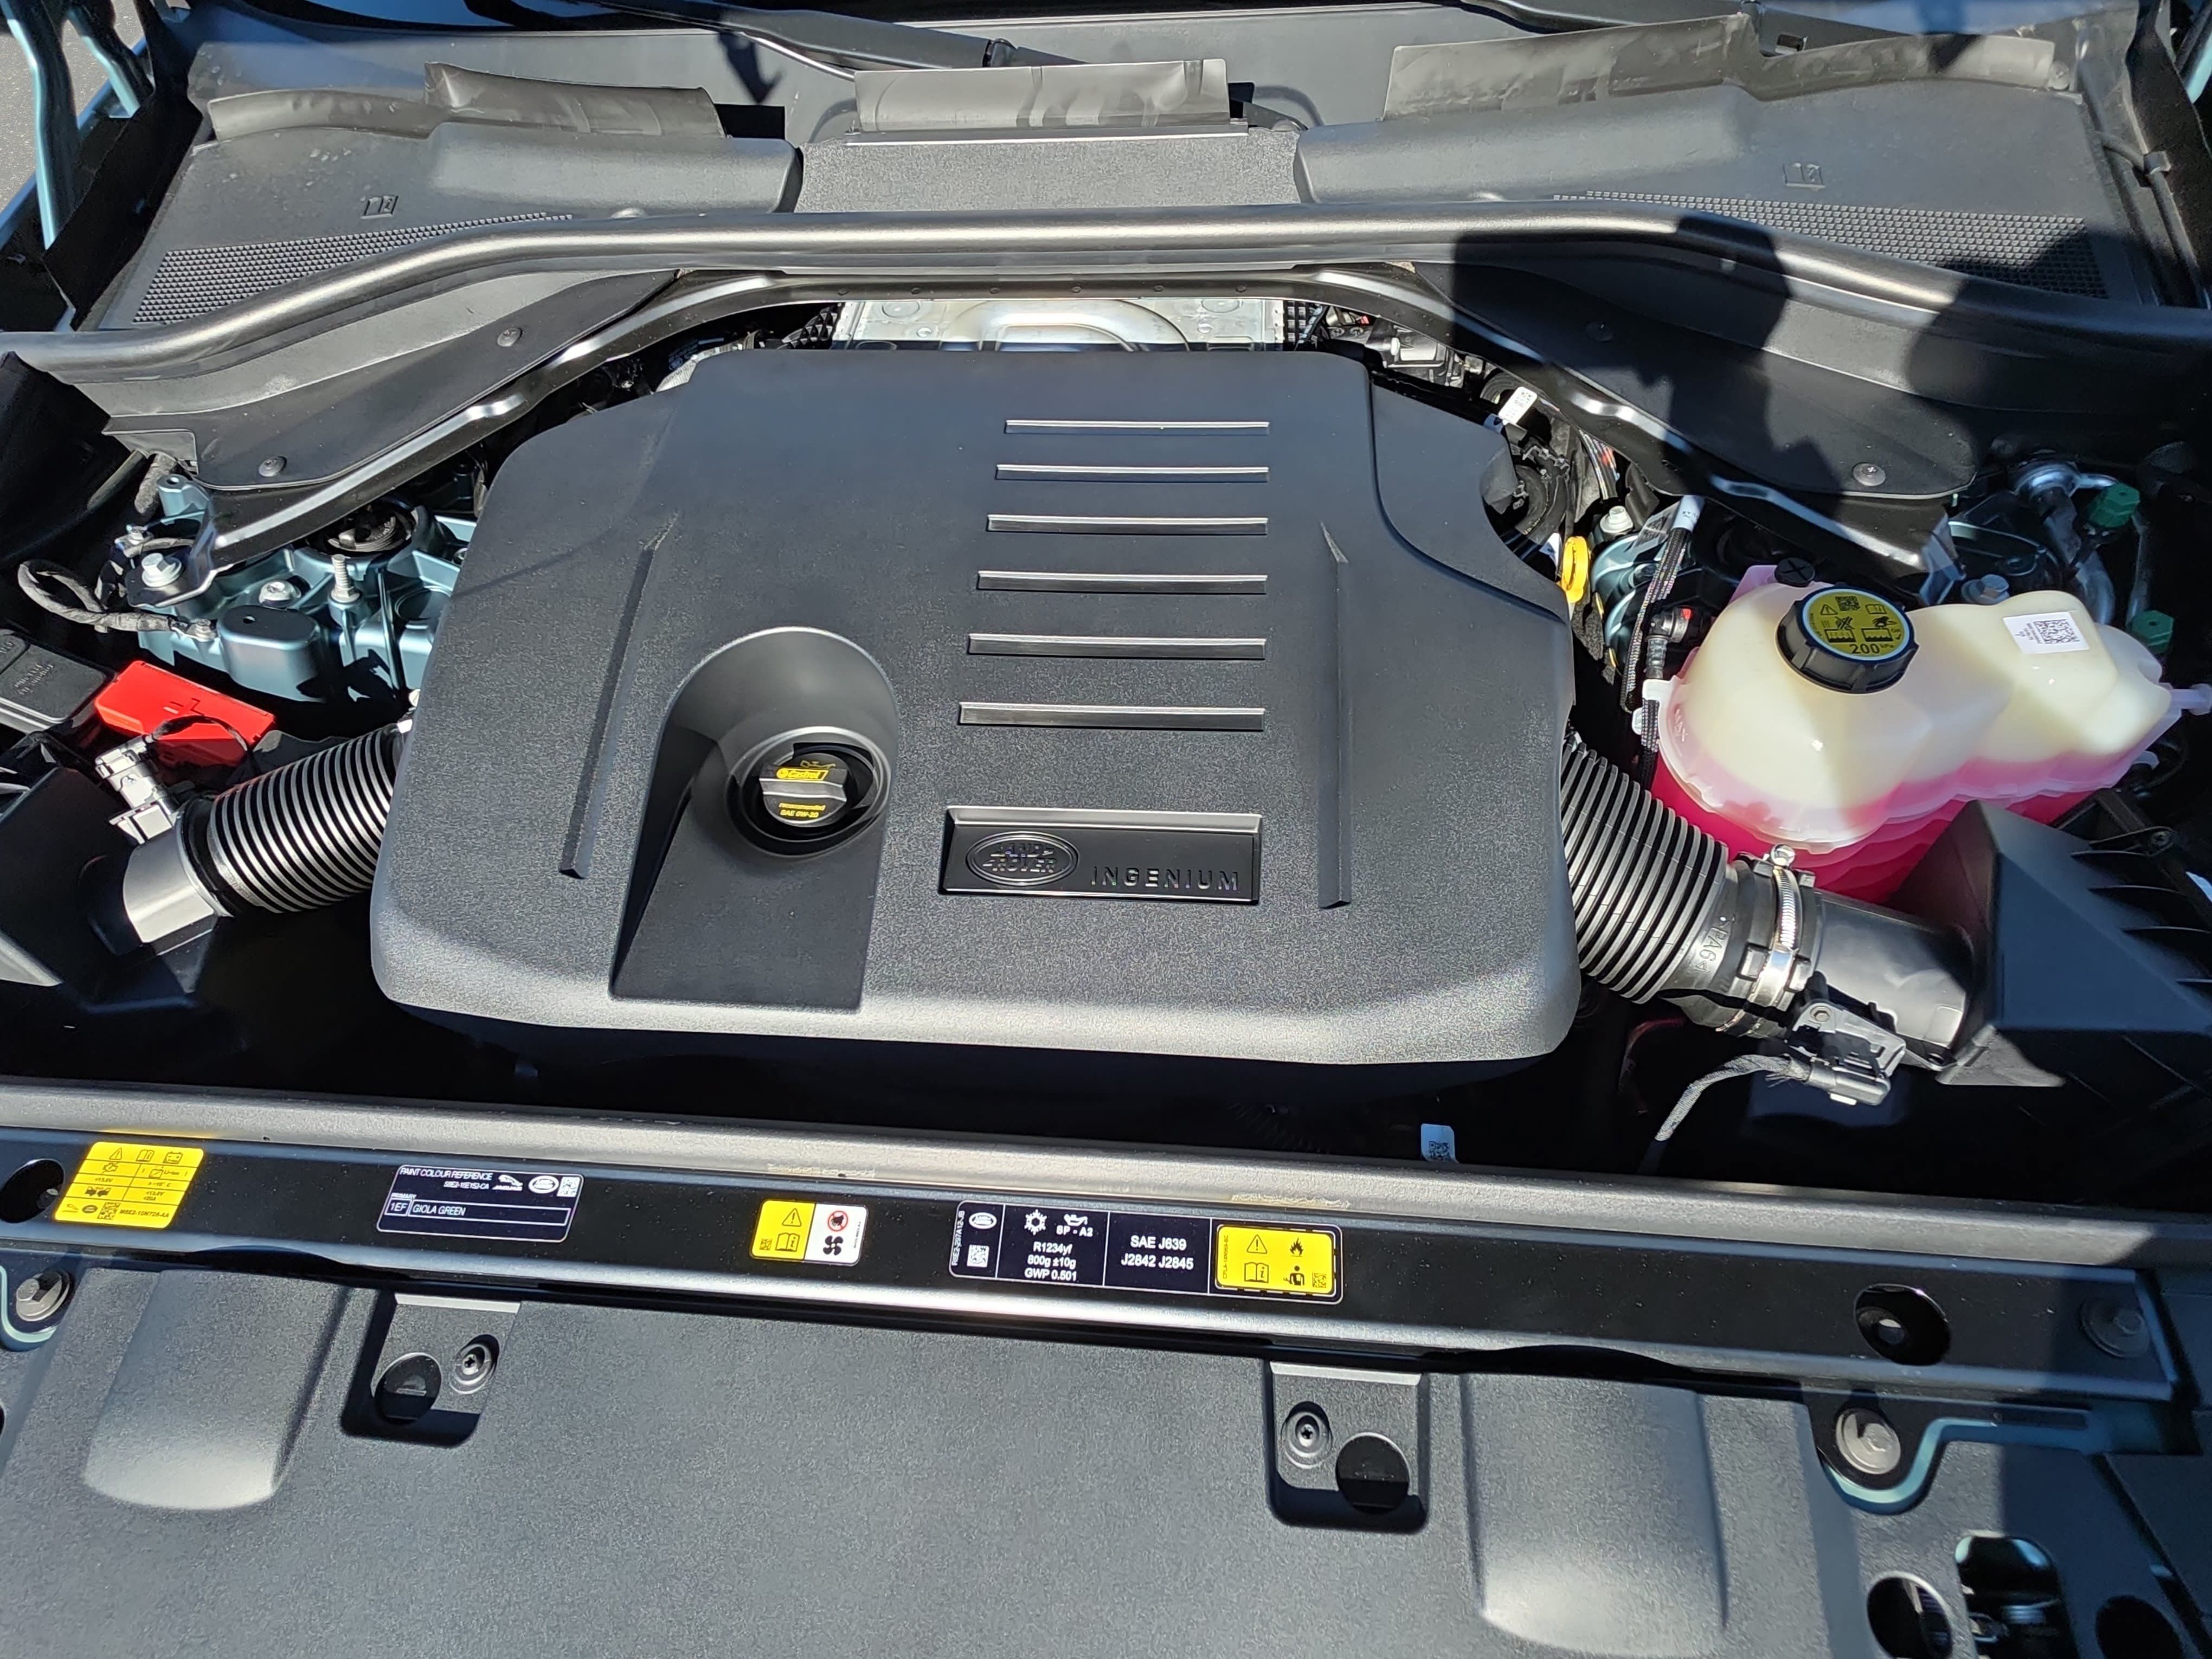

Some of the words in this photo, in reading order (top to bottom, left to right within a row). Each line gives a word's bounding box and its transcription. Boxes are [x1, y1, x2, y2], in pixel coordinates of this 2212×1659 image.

[1849, 643, 1880, 654] 200
[788, 770, 821, 779] Castrol
[991, 857, 1057, 872] ROVER
[1091, 866, 1238, 891] INGENIUM
[400, 1167, 421, 1176] PAINT
[420, 1169, 451, 1178] COLOUR
[451, 1171, 493, 1180] REFERENCE
[390, 1202, 408, 1212] 1EF
[413, 1204, 436, 1214] GIOLA
[438, 1206, 466, 1216] GREEN
[1056, 1225, 1070, 1235] SP
[1079, 1227, 1093, 1237] A2
[1033, 1241, 1073, 1255] R1234yf
[1130, 1235, 1156, 1249] SAE
[1158, 1237, 1187, 1251] J639
[1027, 1255, 1051, 1268] 800g
[1052, 1256, 1076, 1270] ±10g
[1121, 1253, 1156, 1268] J2842
[1158, 1256, 1194, 1270] J2845
[1024, 1268, 1050, 1279] GWP
[1051, 1270, 1077, 1281] 0.501
